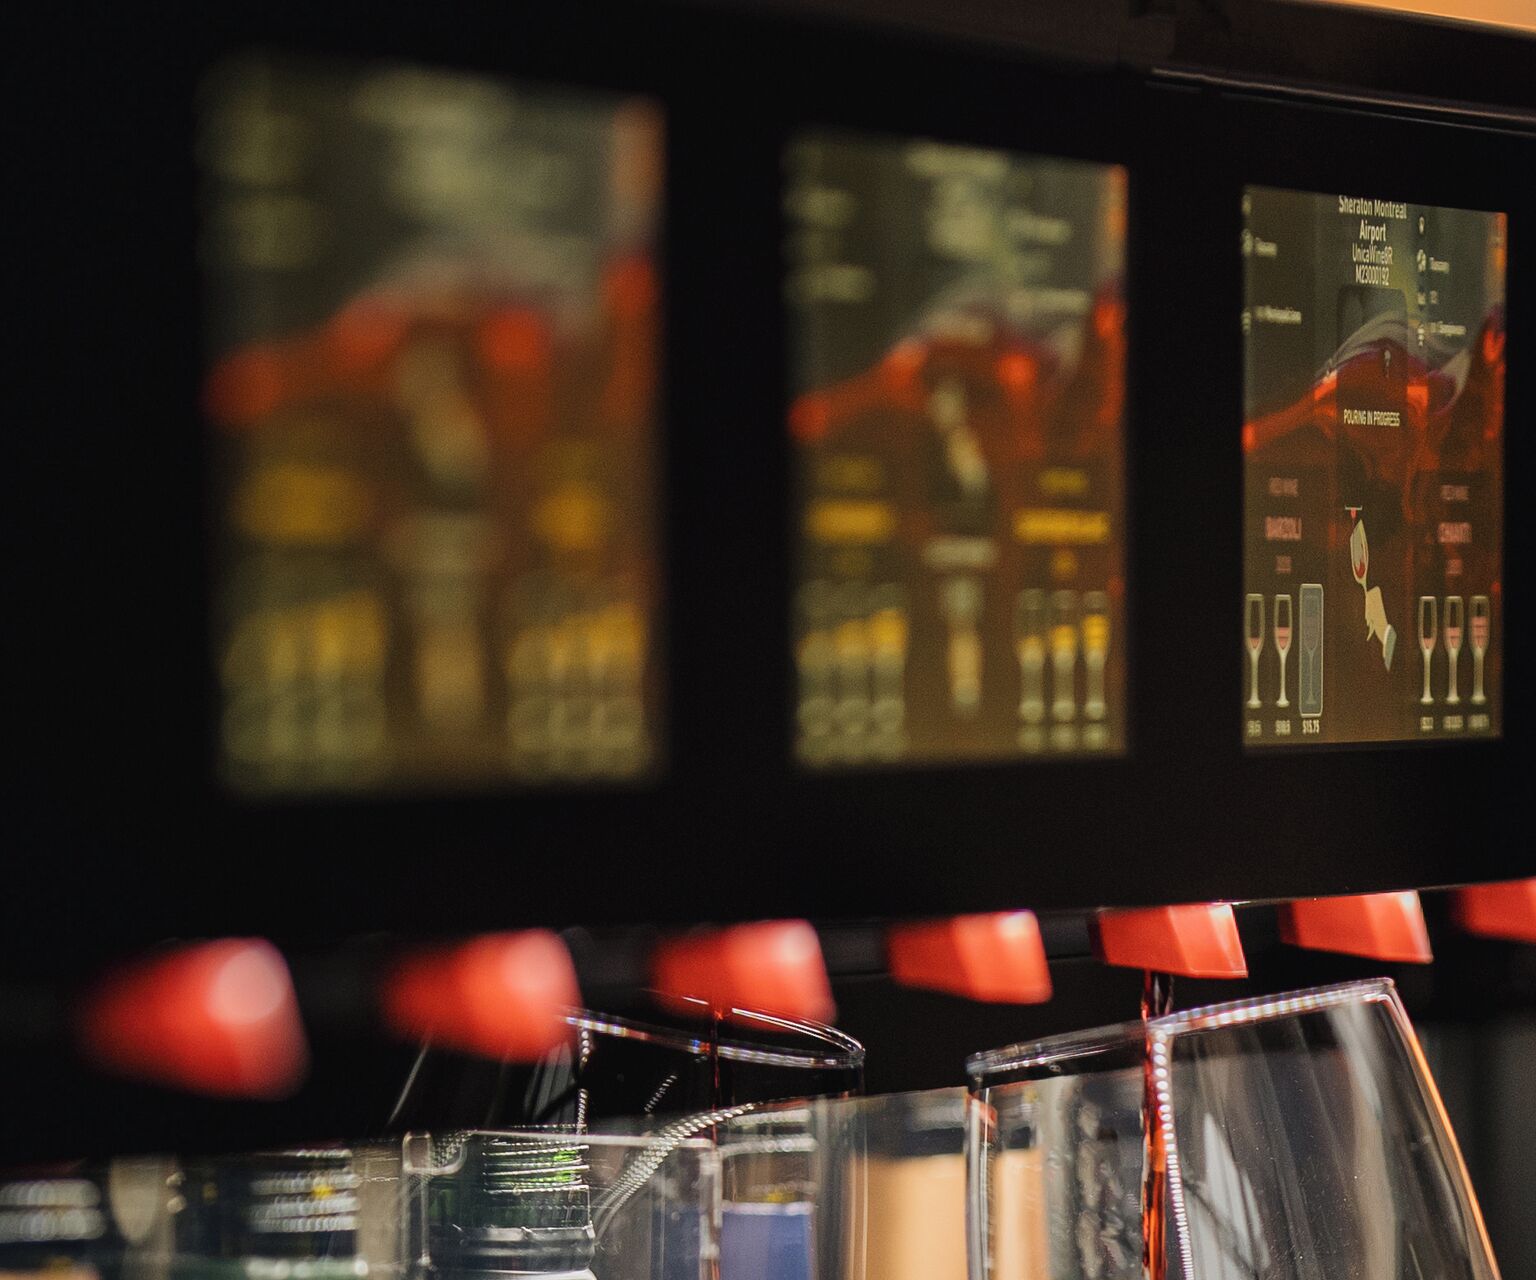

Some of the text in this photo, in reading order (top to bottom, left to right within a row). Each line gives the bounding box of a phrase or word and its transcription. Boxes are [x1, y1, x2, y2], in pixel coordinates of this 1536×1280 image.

[1339, 195, 1407, 219] Sheraton Montreal
[1360, 219, 1386, 245] Airport
[1344, 409, 1400, 427] POURING IN PROGRESS
